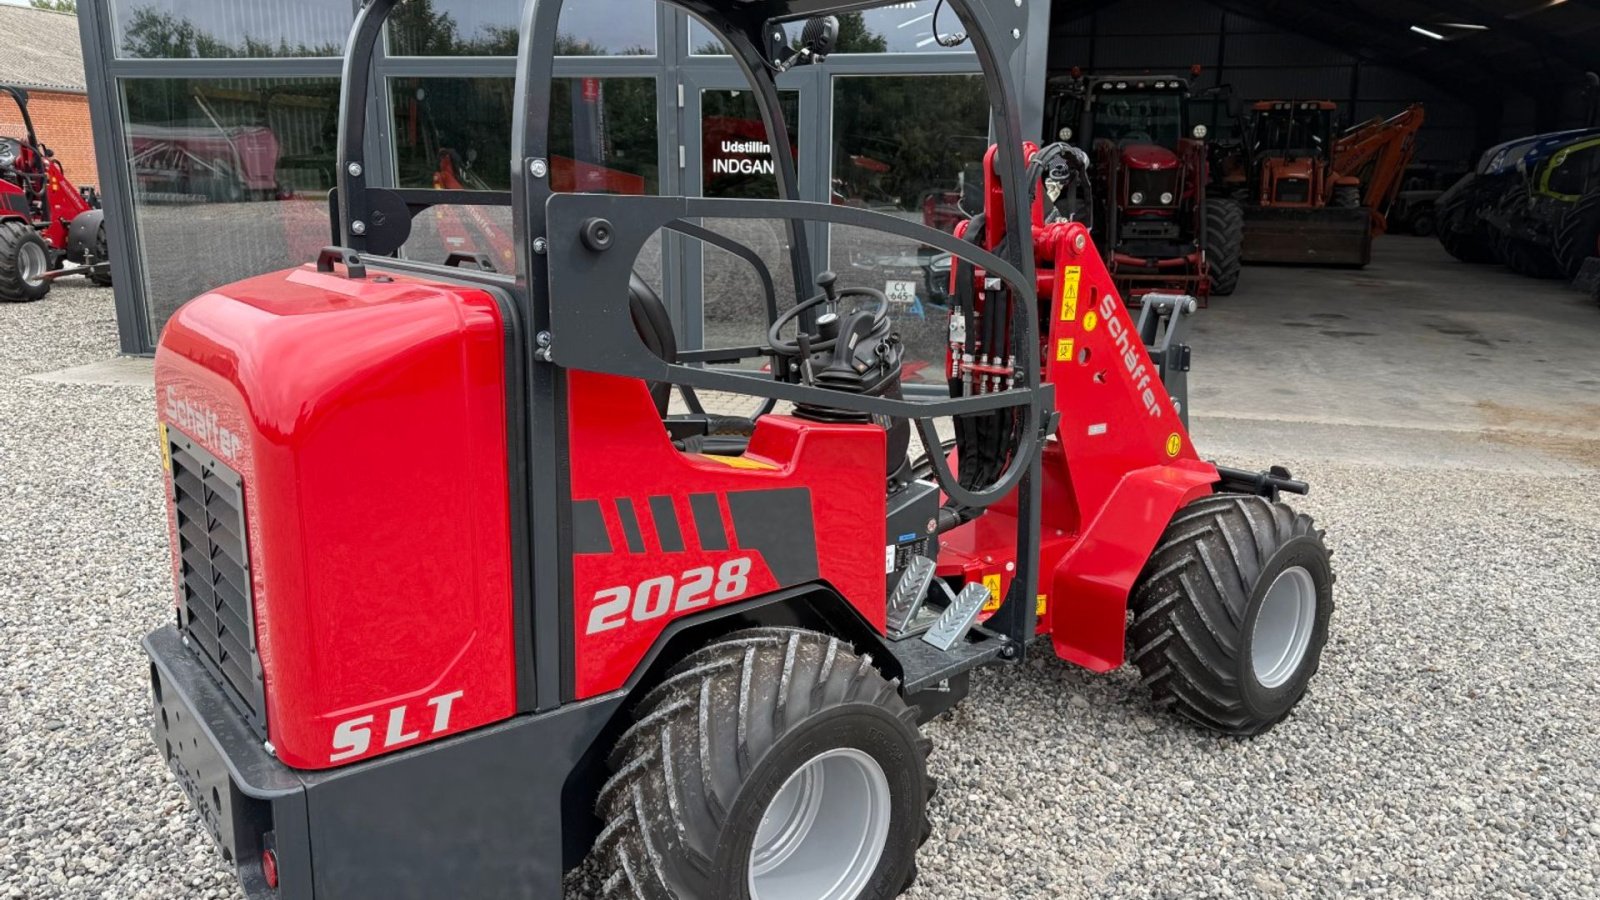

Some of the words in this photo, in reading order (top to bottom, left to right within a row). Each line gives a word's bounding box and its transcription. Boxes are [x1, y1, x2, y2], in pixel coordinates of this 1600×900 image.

[712, 158, 775, 175] INDGAN
[721, 140, 771, 153] Udstillin
[894, 282, 907, 292] CX
[1100, 294, 1162, 418] Schäffer
[586, 556, 752, 635] 2028
[329, 690, 464, 763] SLT
